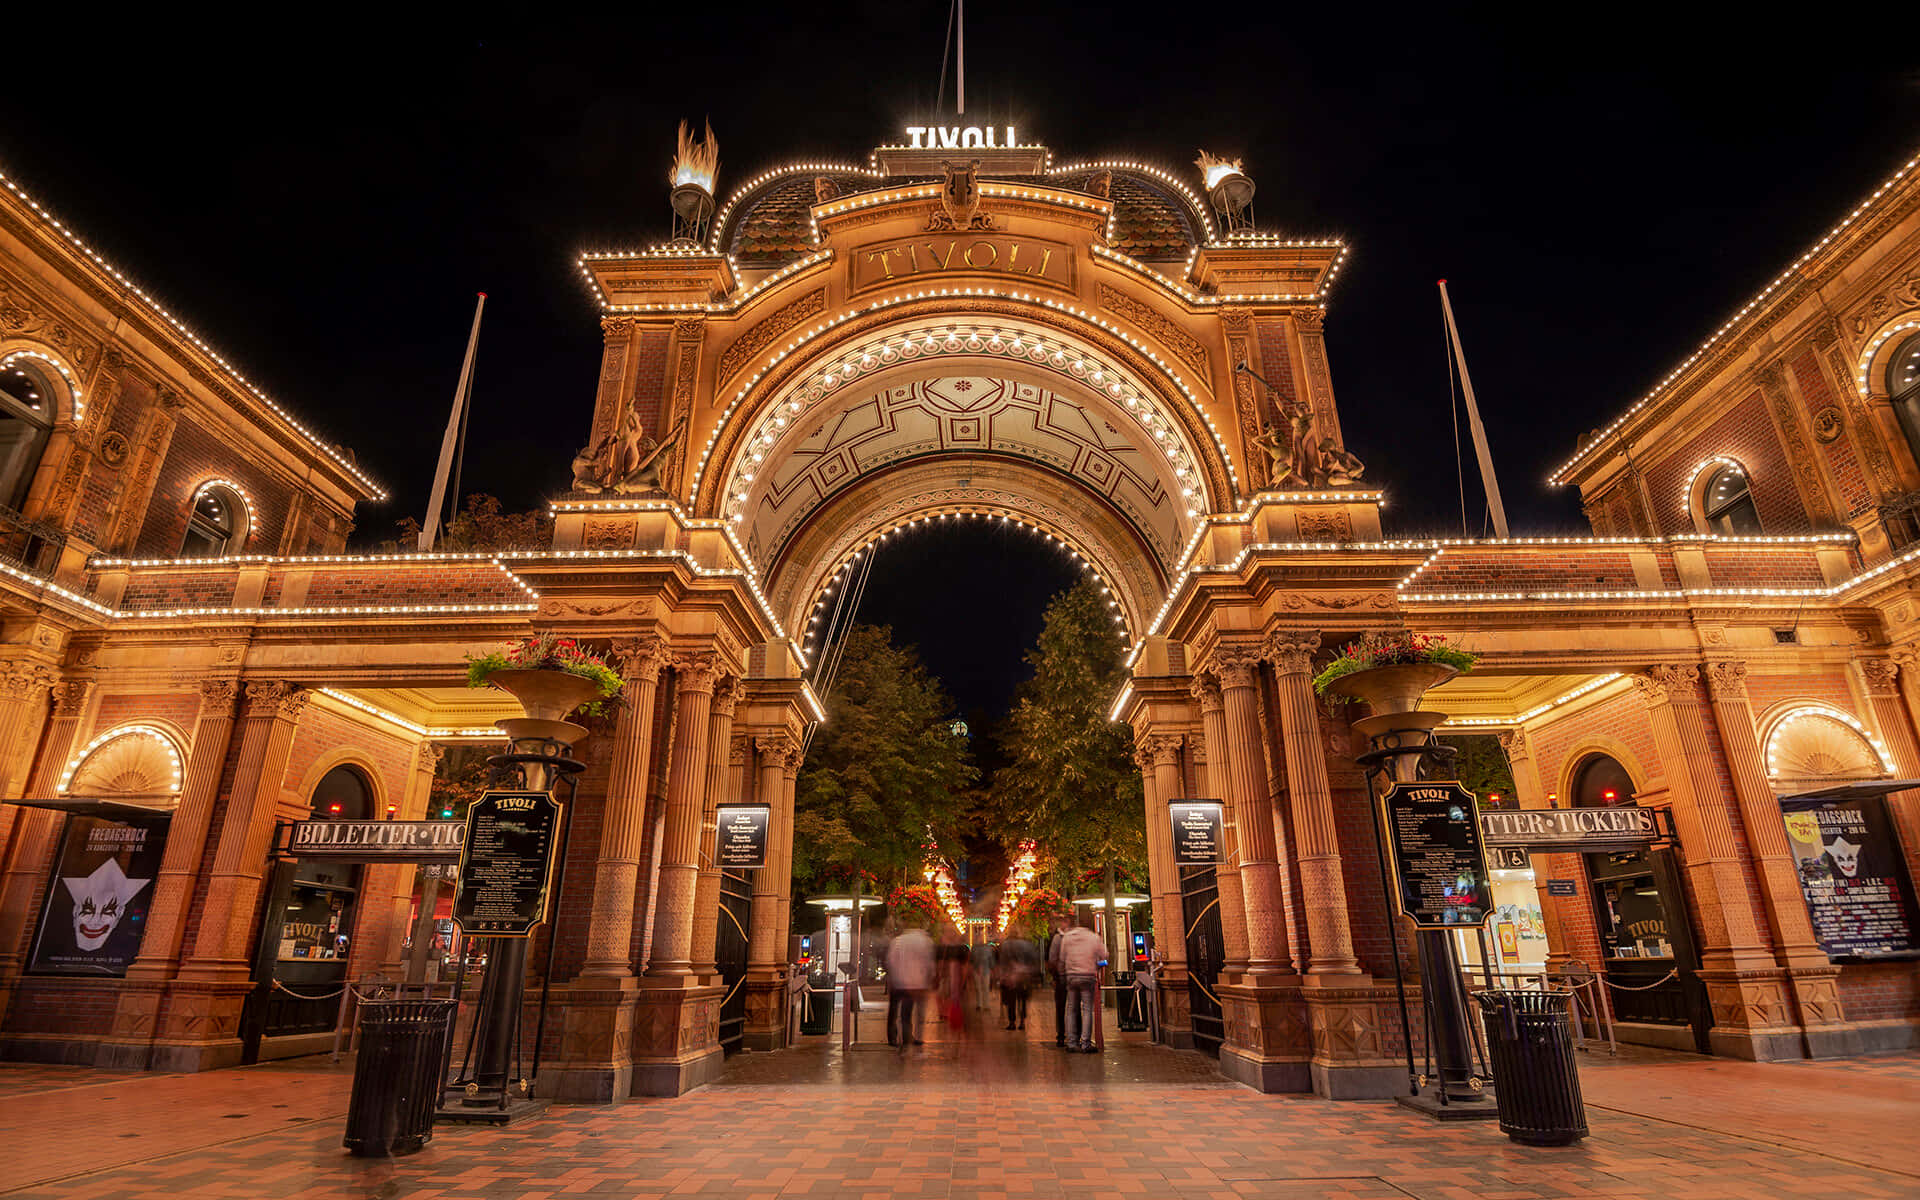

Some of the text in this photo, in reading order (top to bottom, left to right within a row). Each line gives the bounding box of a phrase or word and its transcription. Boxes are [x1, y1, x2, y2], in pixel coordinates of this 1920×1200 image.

[906, 126, 1016, 149] TIVOLI
[867, 241, 1051, 279] TIVOLI
[495, 798, 537, 810] TIVOLI
[1407, 788, 1450, 801] TIVOLI
[1481, 813, 1545, 835] TTER
[1553, 808, 1652, 833] TICKETS
[1815, 809, 1865, 826] EDAGSROCK
[88, 827, 149, 842] FREDAGSROCK
[296, 824, 416, 846] BILLETTER
[430, 825, 468, 846] TIC
[1628, 919, 1667, 938] TIVOL
